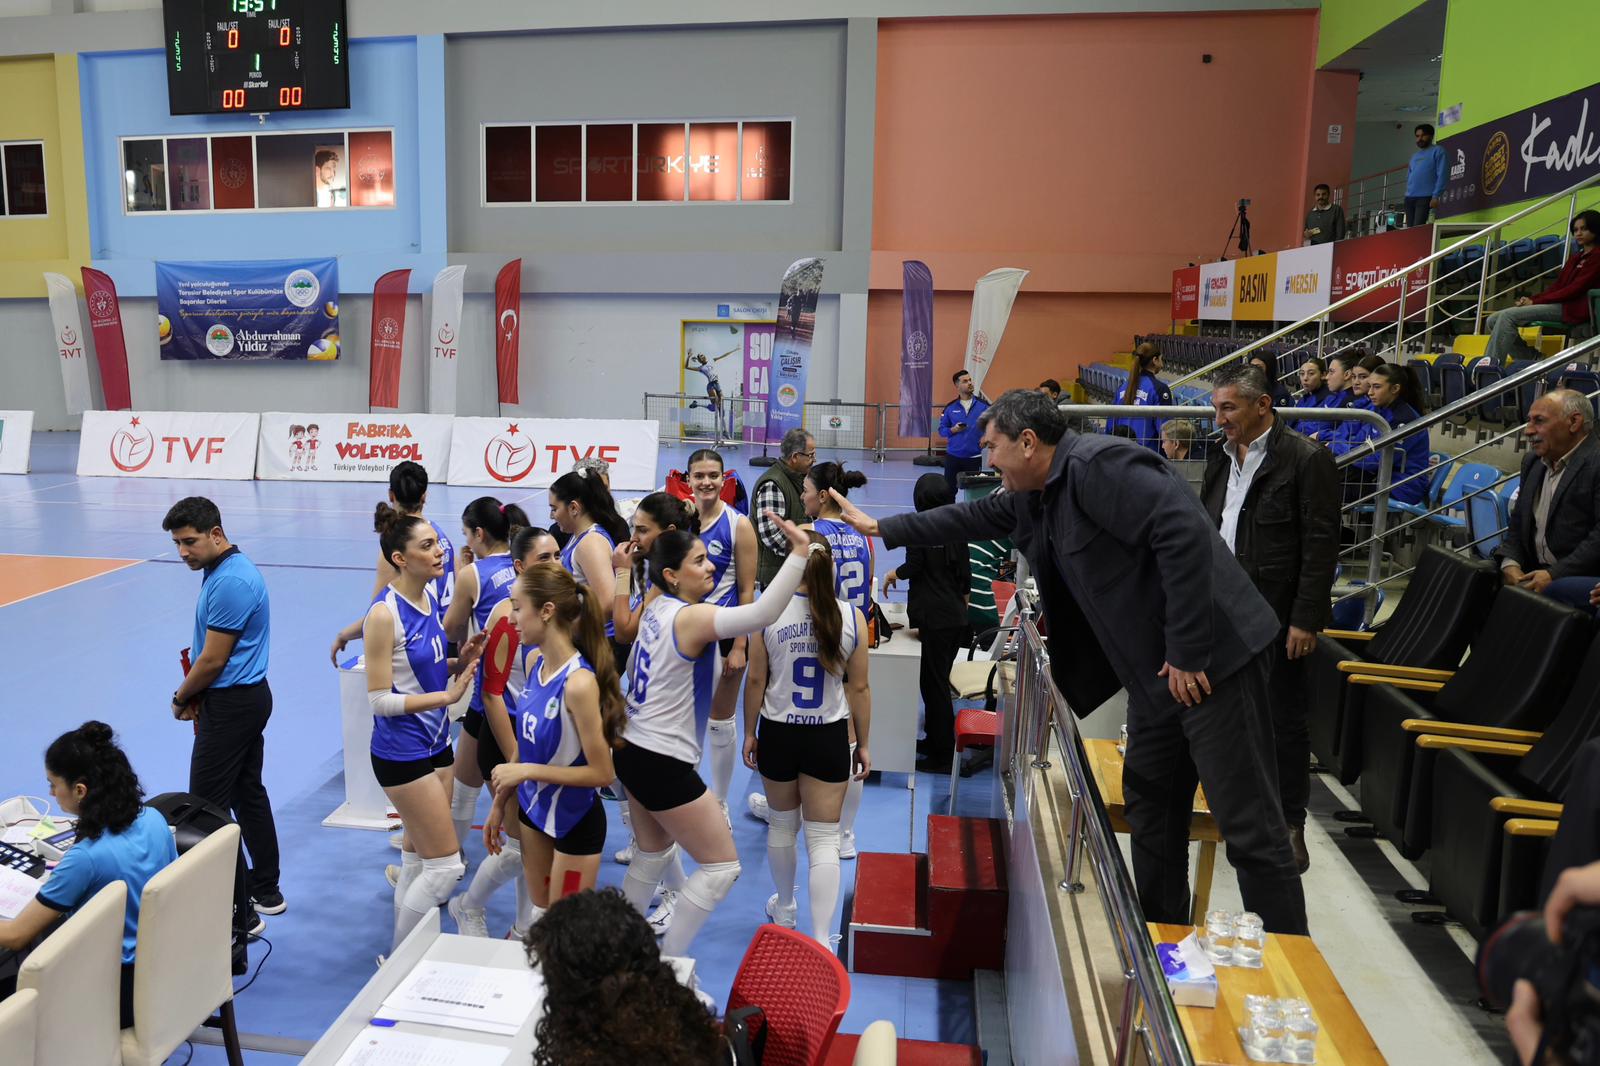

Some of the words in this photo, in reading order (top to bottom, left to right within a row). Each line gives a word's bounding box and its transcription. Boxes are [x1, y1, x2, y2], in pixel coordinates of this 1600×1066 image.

[228, 30, 238, 48] 0
[280, 27, 290, 46] 0
[222, 89, 245, 109] 00
[279, 87, 302, 106] 00
[1521, 97, 1600, 193] Kadı
[1239, 272, 1268, 303] BASIN
[1284, 269, 1319, 294] #MERSİN
[202, 289, 232, 297] Belediyesi
[233, 289, 247, 297] Spor
[235, 328, 301, 341] Abdurrahman
[237, 341, 268, 352] Yıldız
[434, 347, 457, 359] TVF
[161, 436, 226, 464] TVF
[335, 441, 423, 461] VOLEYBOL
[545, 445, 620, 473] TVF
[333, 463, 356, 472] Türkiye
[357, 463, 385, 472] Voleybol
[490, 566, 517, 589] TOROSLA
[777, 622, 808, 645] TOROSLAR
[431, 635, 444, 664] 11
[790, 642, 806, 653] SPOR
[632, 640, 652, 705] 16
[792, 657, 825, 709] 9
[522, 711, 537, 745] 13
